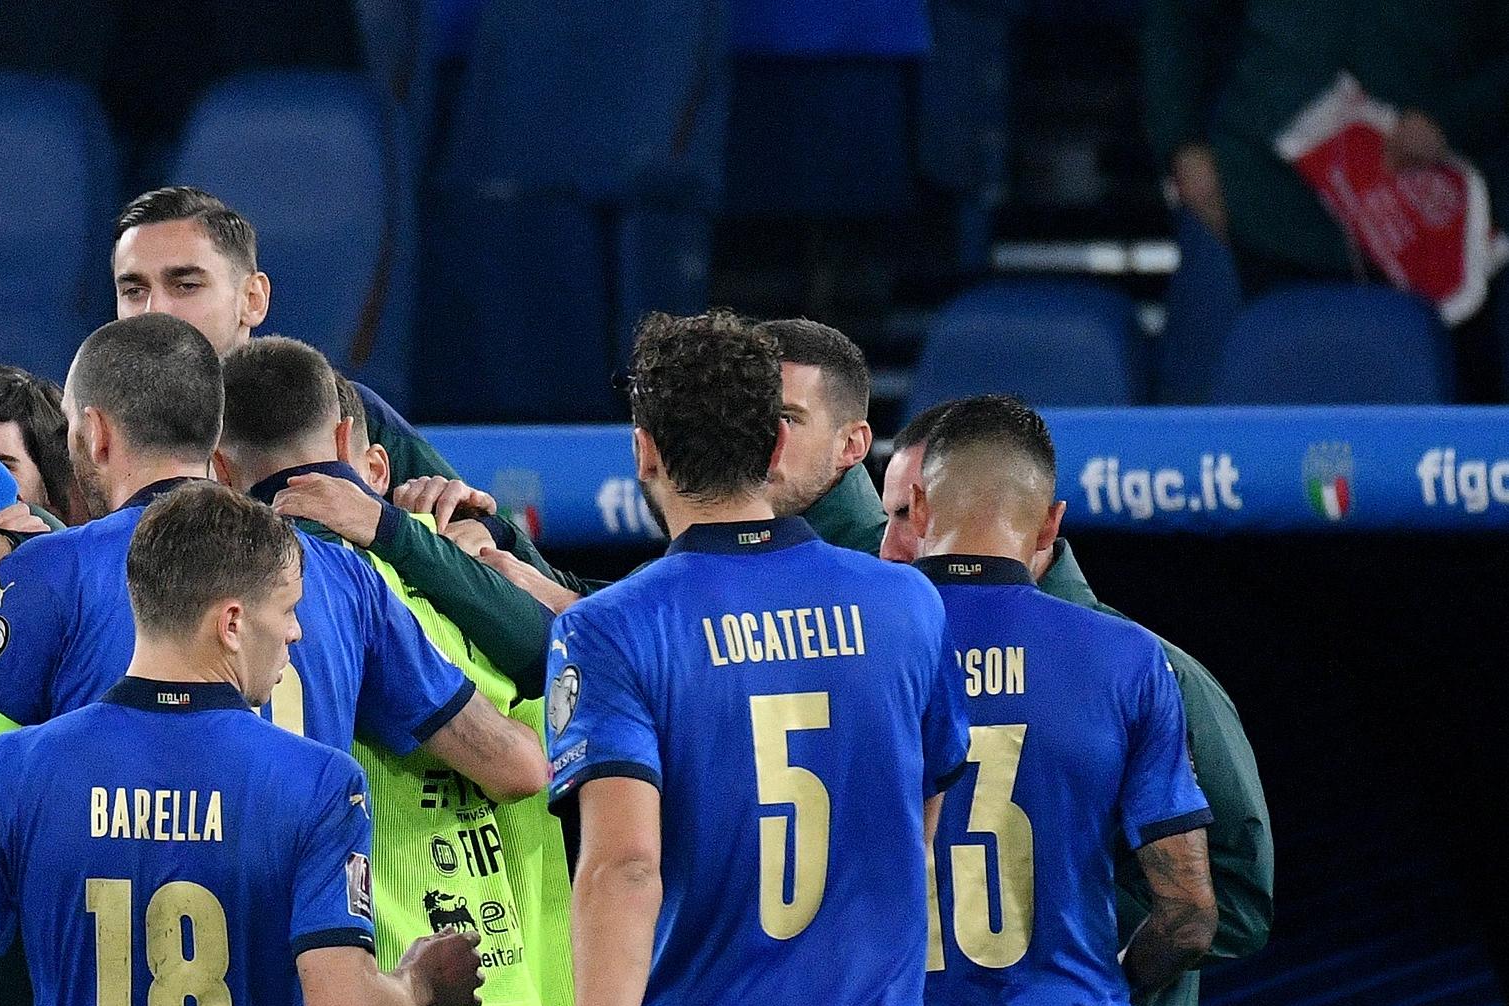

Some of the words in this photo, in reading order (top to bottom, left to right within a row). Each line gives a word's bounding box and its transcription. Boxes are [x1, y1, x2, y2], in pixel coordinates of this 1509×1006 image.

[1081, 455, 1242, 520] figc.it
[737, 530, 772, 544] ITALIA
[948, 563, 982, 575] ITALIA
[701, 604, 865, 667] LOCATELLI
[955, 646, 1025, 697] SON
[157, 692, 190, 705] ITALIA
[90, 786, 223, 842] BARELLA
[749, 691, 831, 940] 5
